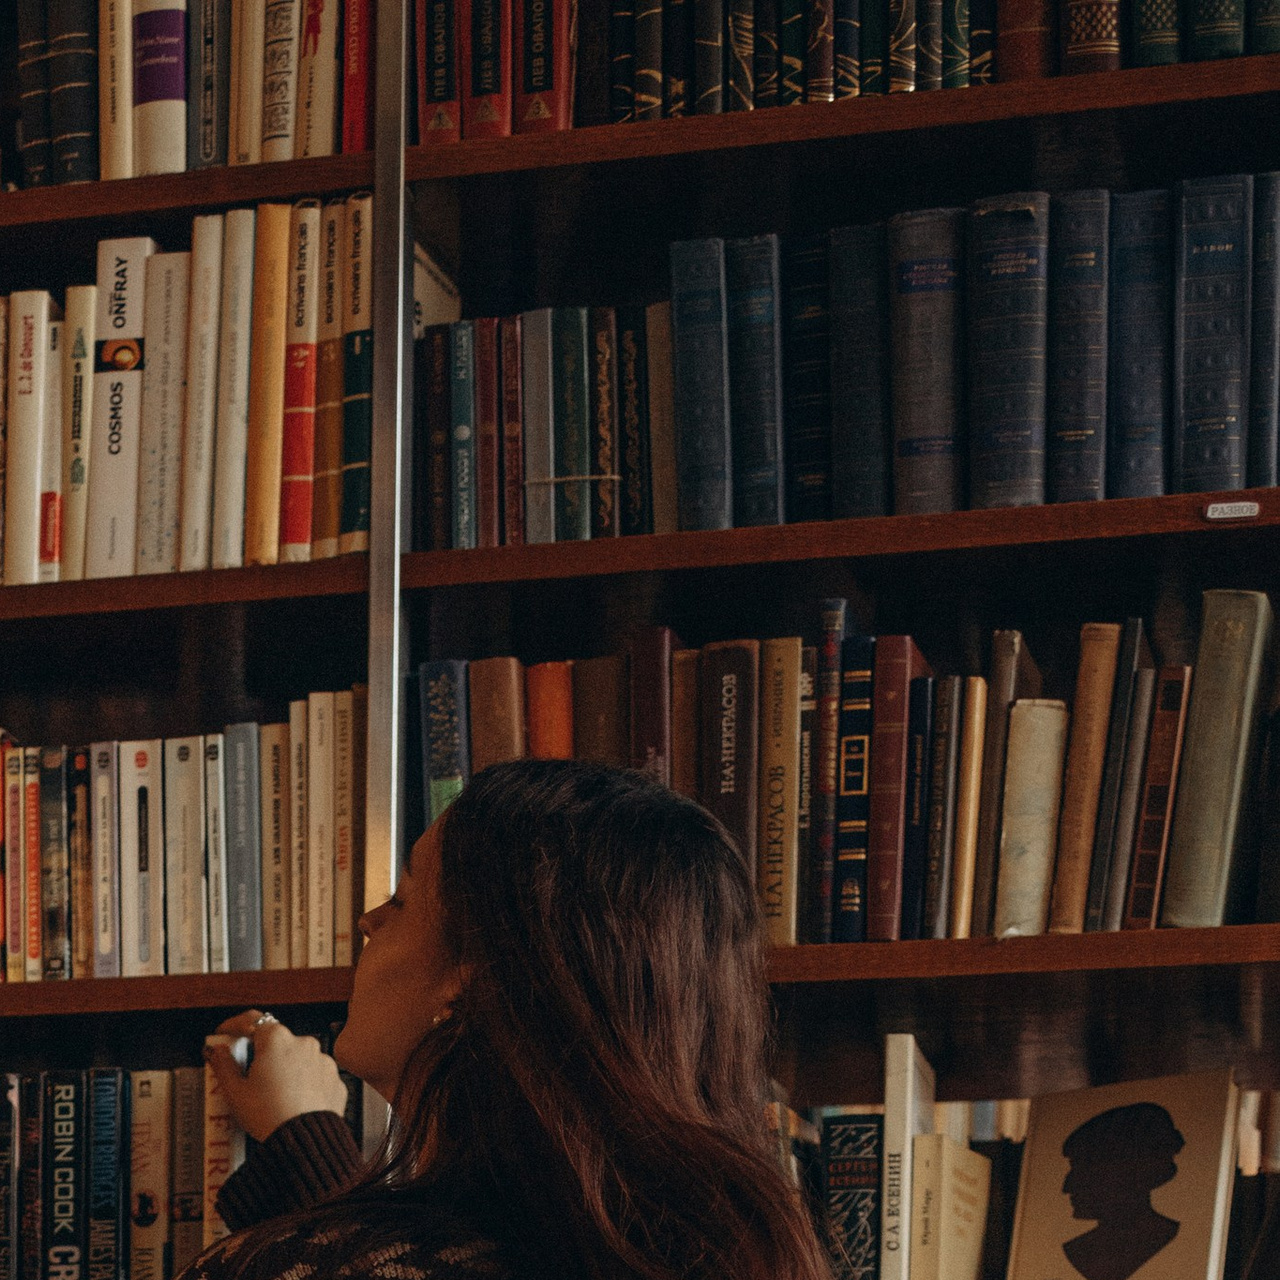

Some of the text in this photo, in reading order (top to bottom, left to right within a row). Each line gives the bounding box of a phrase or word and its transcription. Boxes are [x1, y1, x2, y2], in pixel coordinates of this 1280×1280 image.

[292, 223, 309, 327] écrivains français
[322, 219, 340, 267] français
[347, 208, 365, 316] écrivains français
[111, 256, 129, 329] ONFRAY
[107, 380, 124, 455] COSMOS
[1209, 504, 1256, 517] РАЗНОЕ
[53, 1084, 75, 1161] ROBIN
[92, 1077, 116, 1140] LONDON
[53, 1167, 75, 1234] COOK
[91, 1146, 116, 1208] BRIDGES
[886, 1152, 903, 1217] ЕСЕНИН
[89, 1218, 115, 1261] JAMES
